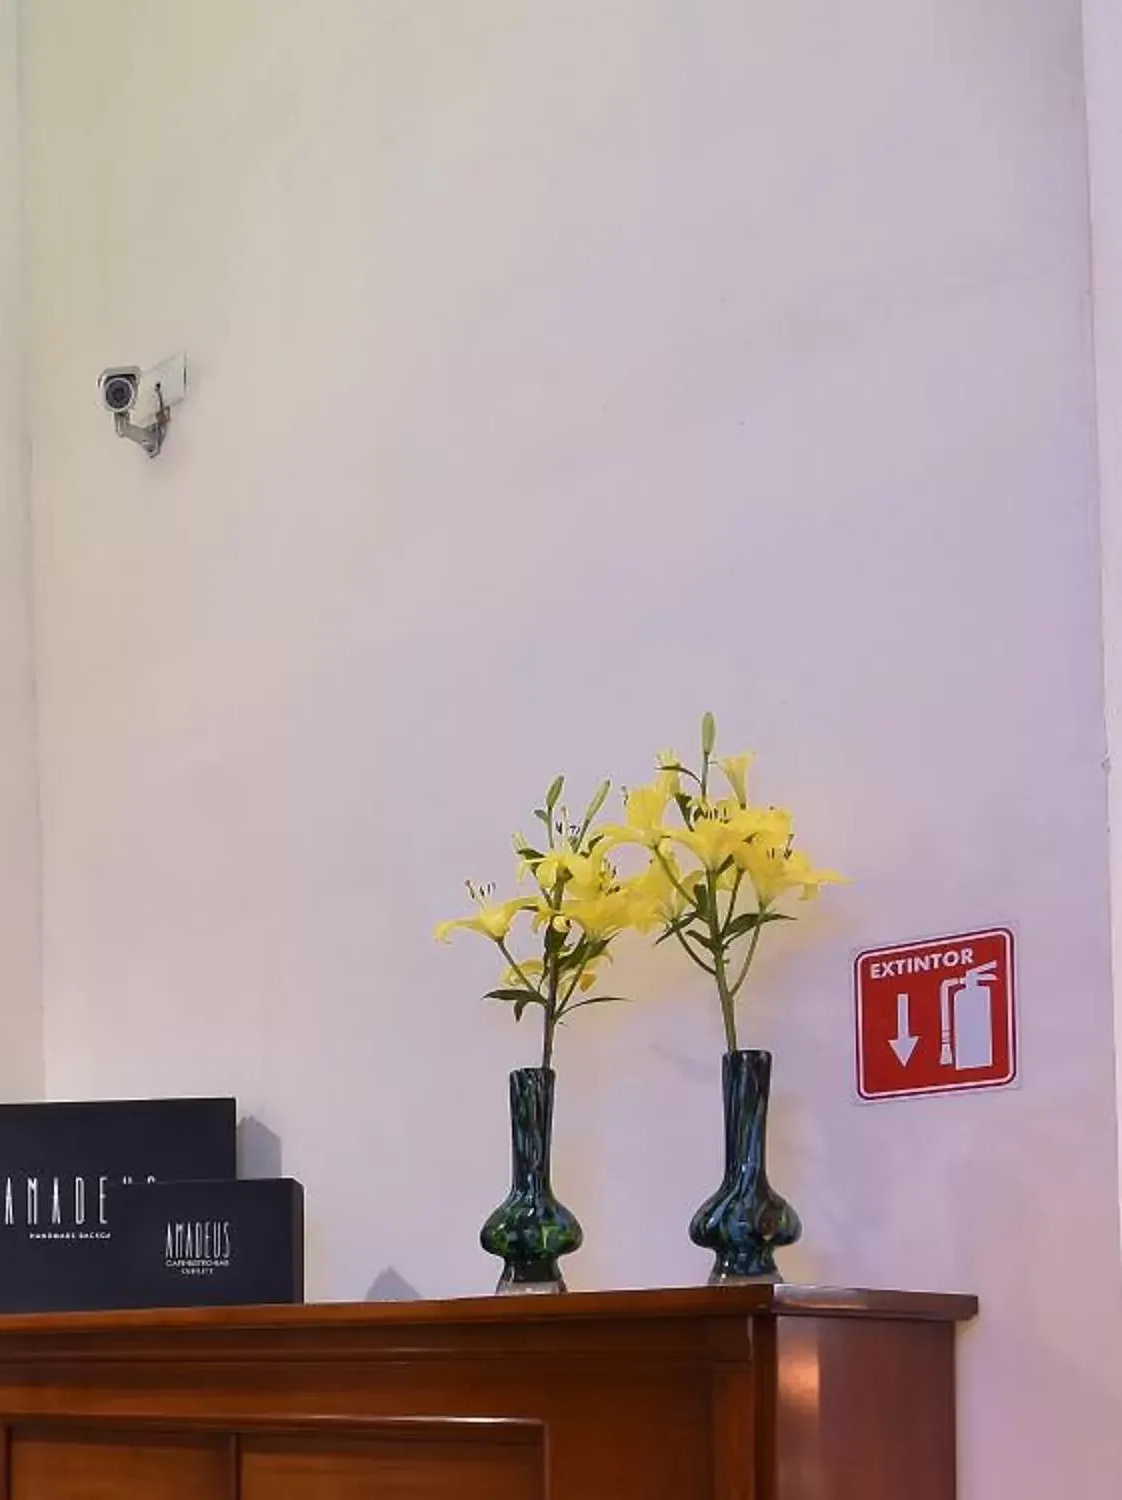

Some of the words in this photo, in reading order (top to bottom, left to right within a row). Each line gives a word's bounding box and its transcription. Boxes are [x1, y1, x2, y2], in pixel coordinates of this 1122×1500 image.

[870, 948, 974, 979] EXTINTOR
[5, 1176, 156, 1225] AMADE
[165, 1221, 230, 1259] AMADEUS
